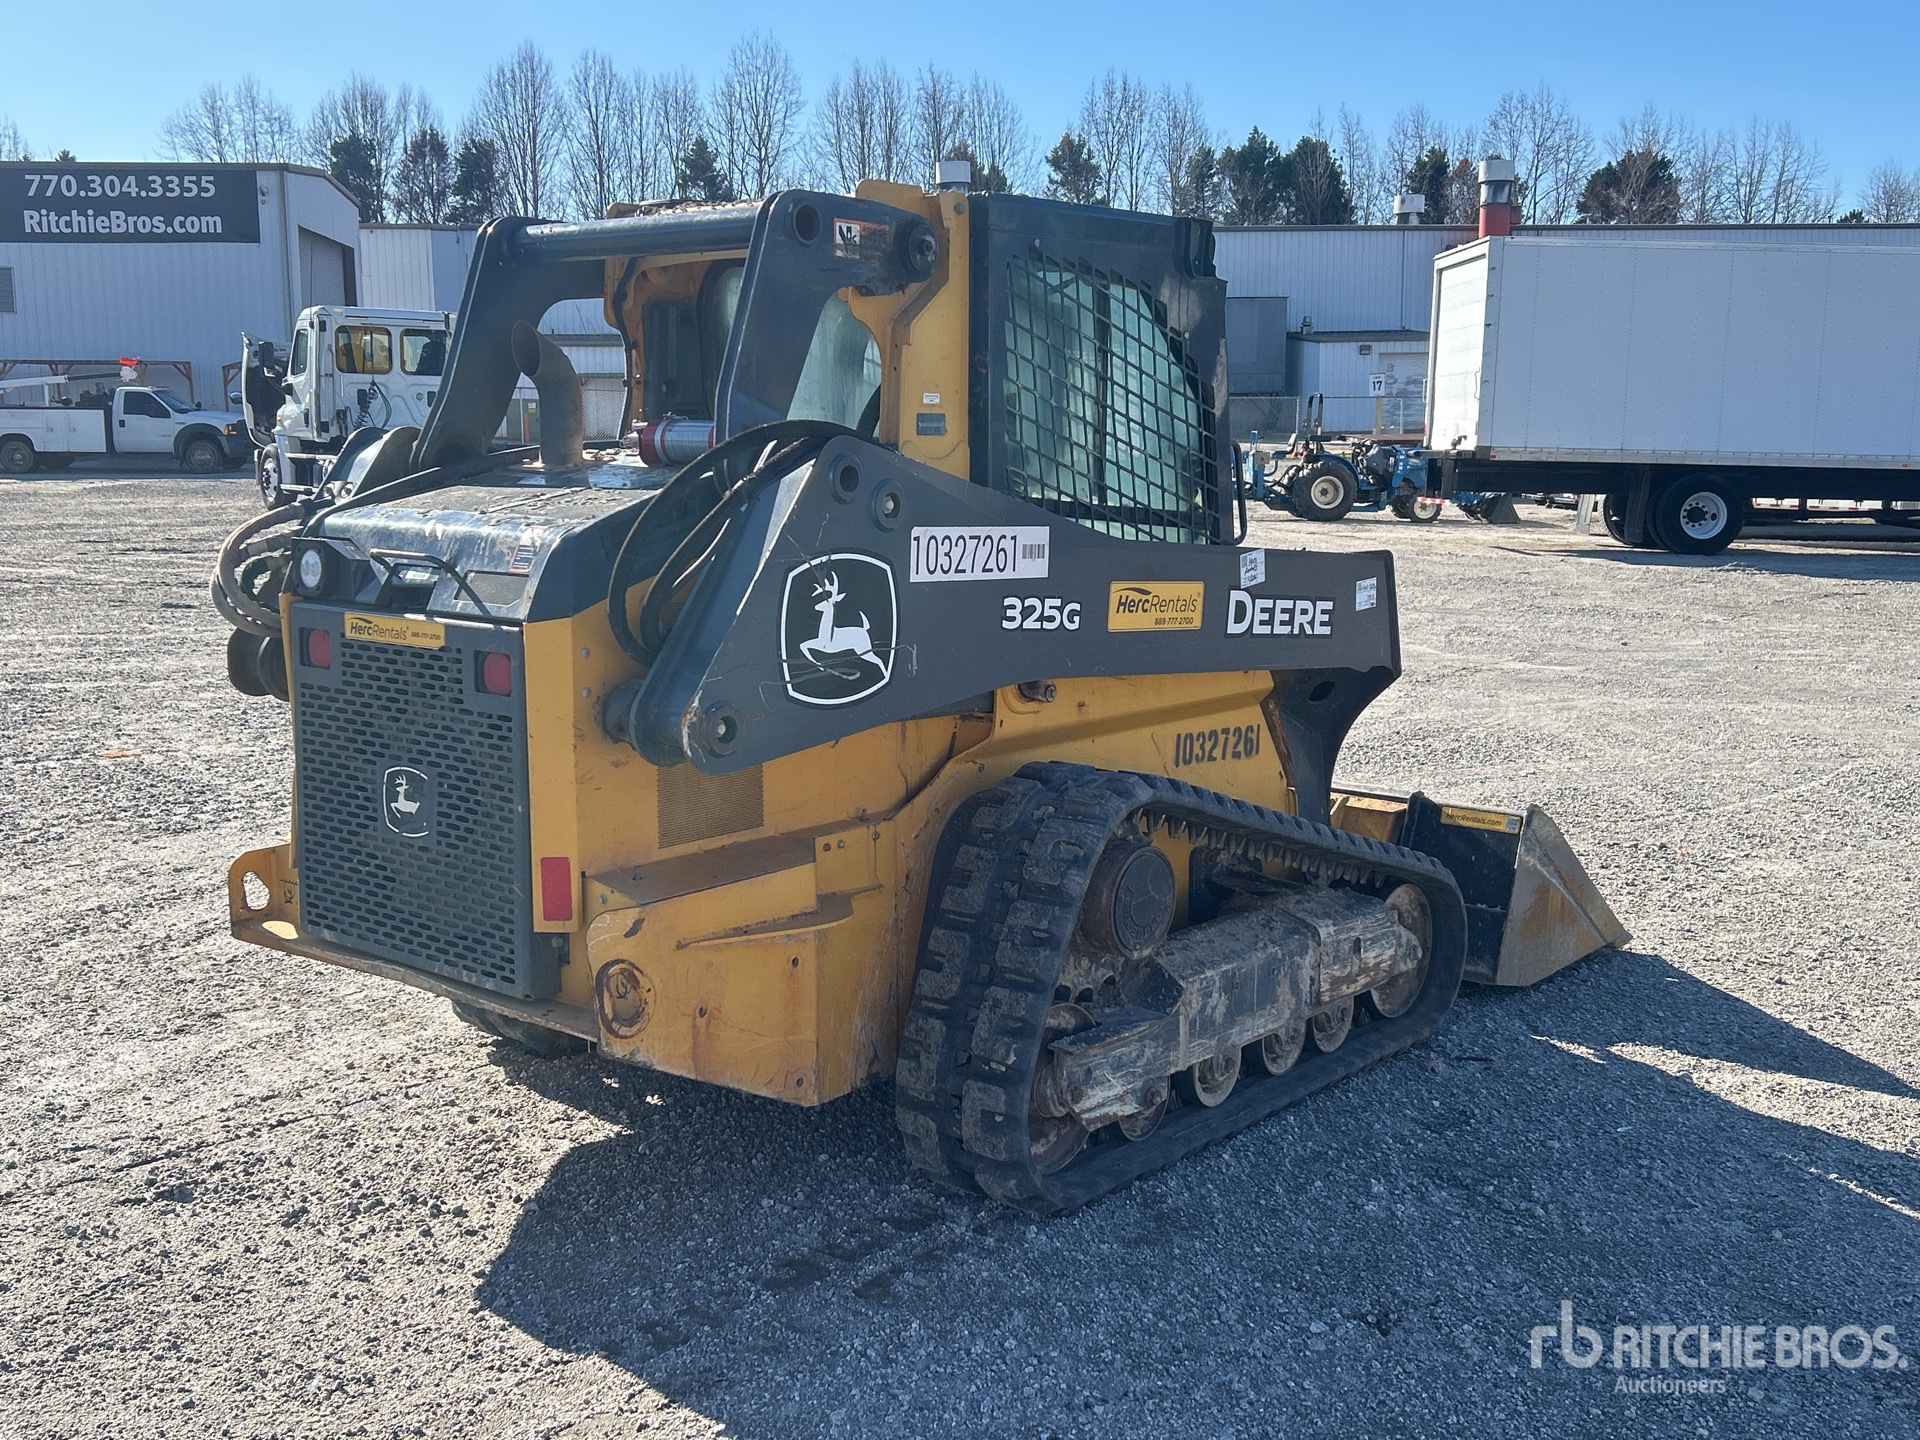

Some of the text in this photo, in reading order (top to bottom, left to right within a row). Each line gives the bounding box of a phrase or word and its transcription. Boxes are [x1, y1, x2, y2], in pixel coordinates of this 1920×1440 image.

[24, 174, 216, 198] 770.304.3355
[23, 209, 222, 234] RitchieBros.com
[1372, 380, 1383, 391] 17
[913, 534, 1018, 575] 10327261
[1002, 596, 1081, 631] 325G
[1116, 594, 1198, 614] HercRentals
[1226, 589, 1334, 635] DEERE
[350, 621, 408, 641] HercRentals
[1154, 616, 1194, 626] 888-777-2700
[1174, 724, 1261, 768] 10327261
[1446, 813, 1503, 827] HercRentals.com
